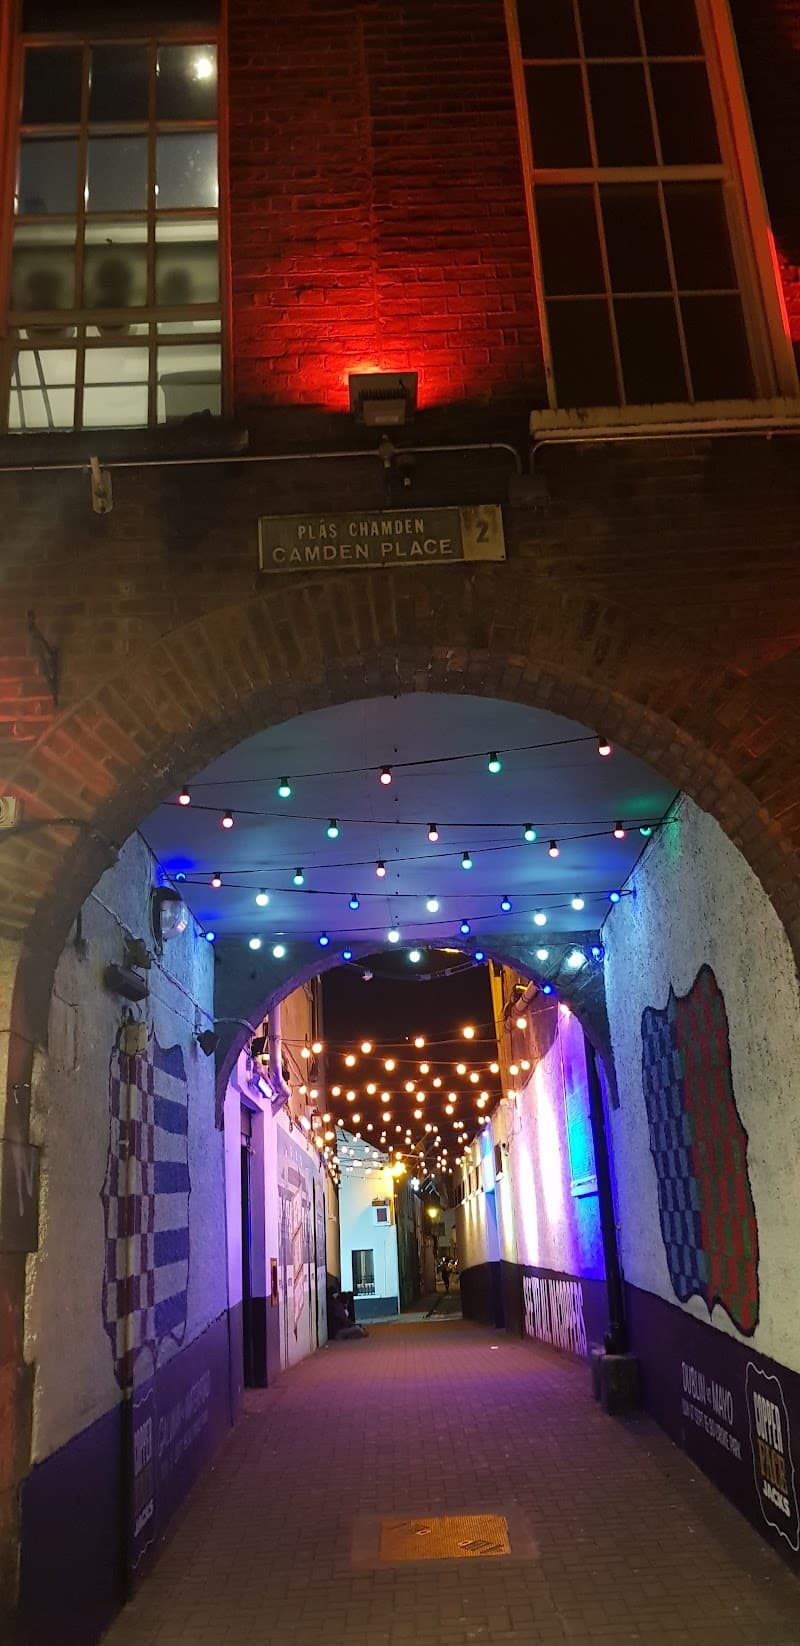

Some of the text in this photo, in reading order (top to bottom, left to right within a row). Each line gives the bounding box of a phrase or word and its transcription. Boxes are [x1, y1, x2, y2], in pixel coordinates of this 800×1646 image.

[349, 519, 425, 537] CHAMDEN
[475, 520, 489, 543] 2
[272, 539, 453, 563] CAMDEN PLACE
[682, 1361, 705, 1405] DUBLIN
[711, 1380, 733, 1425] MAYO
[753, 1391, 784, 1453] COPPER
[759, 1440, 788, 1495] FACE
[762, 1479, 791, 1518] JACKS
